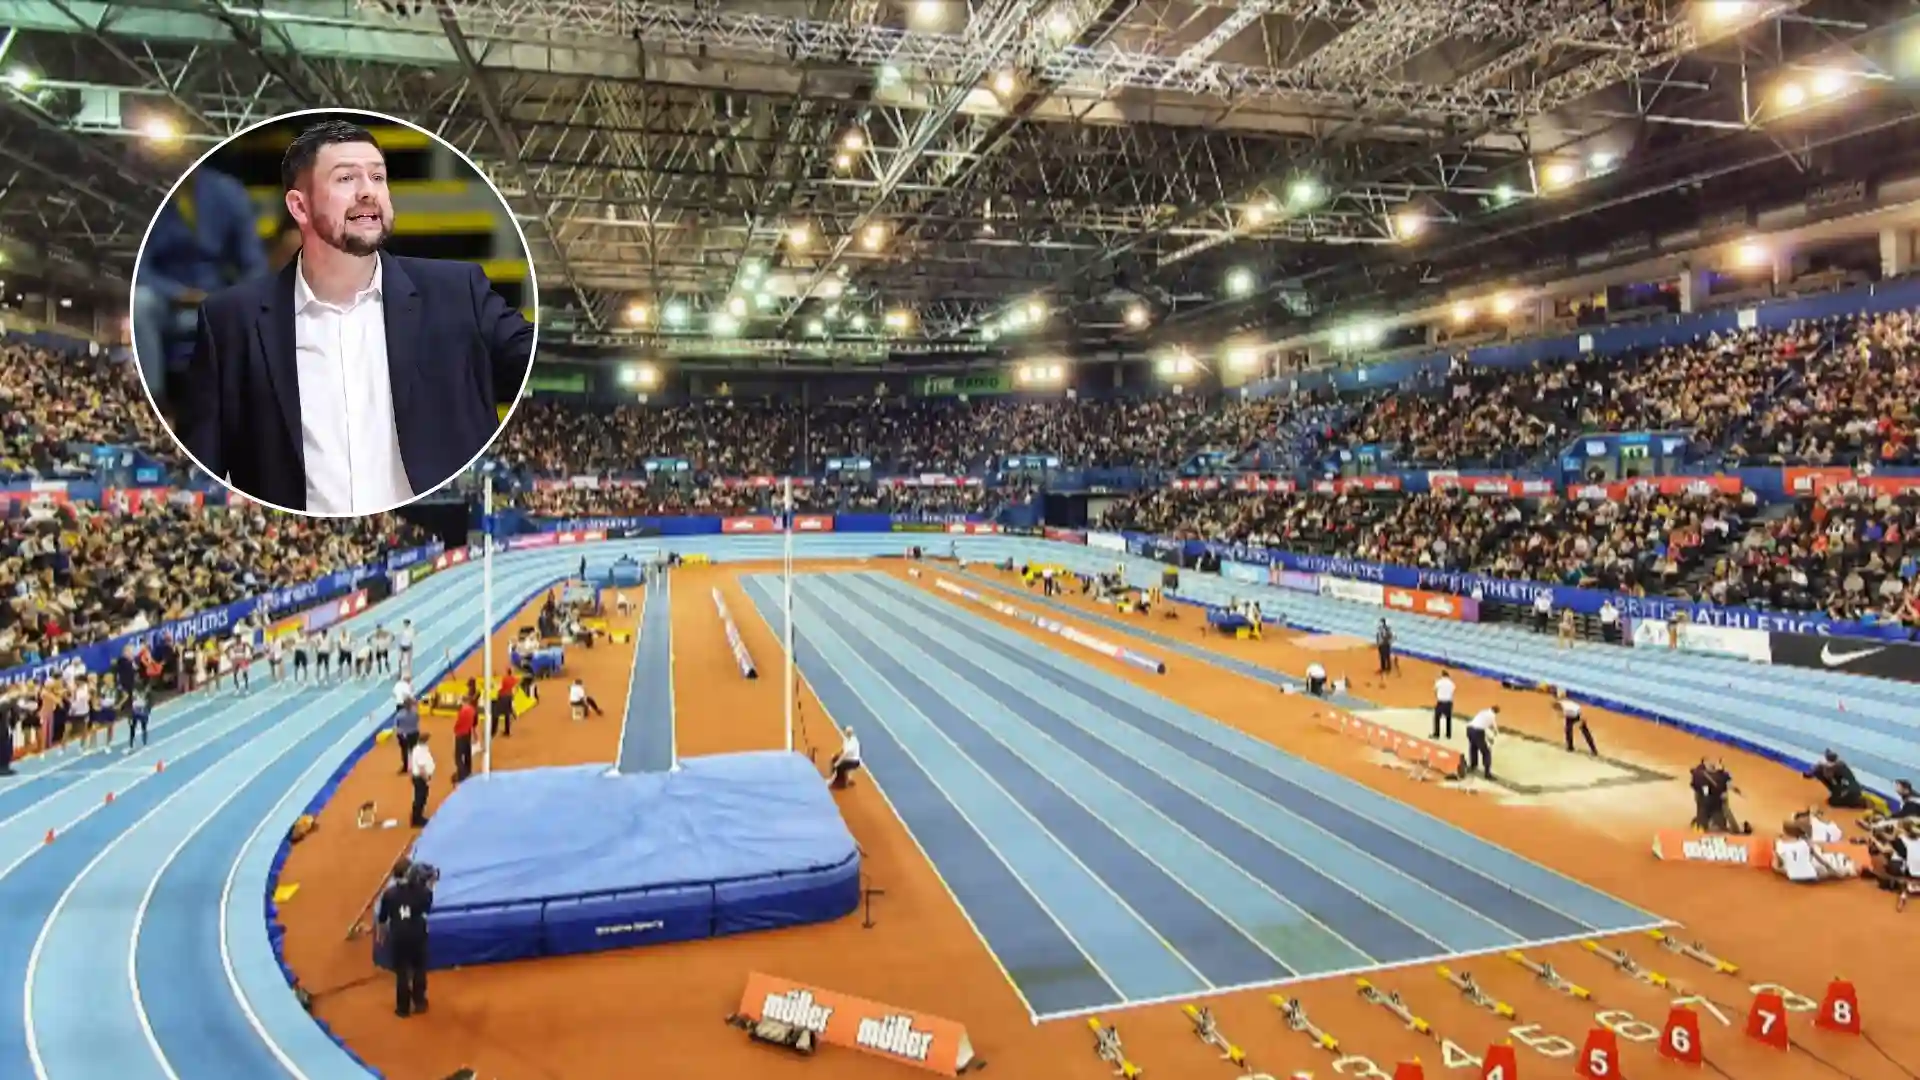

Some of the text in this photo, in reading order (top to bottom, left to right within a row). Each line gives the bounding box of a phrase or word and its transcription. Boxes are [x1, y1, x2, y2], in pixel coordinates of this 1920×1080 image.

[1615, 597, 1831, 635] BRITIS ATHLETICS
[762, 989, 833, 1033] müller
[1757, 1009, 1777, 1035] 7
[1833, 999, 1852, 1025] 8
[856, 1014, 933, 1061] müller
[1670, 1026, 1691, 1053] 6
[1589, 1048, 1609, 1076] 5
